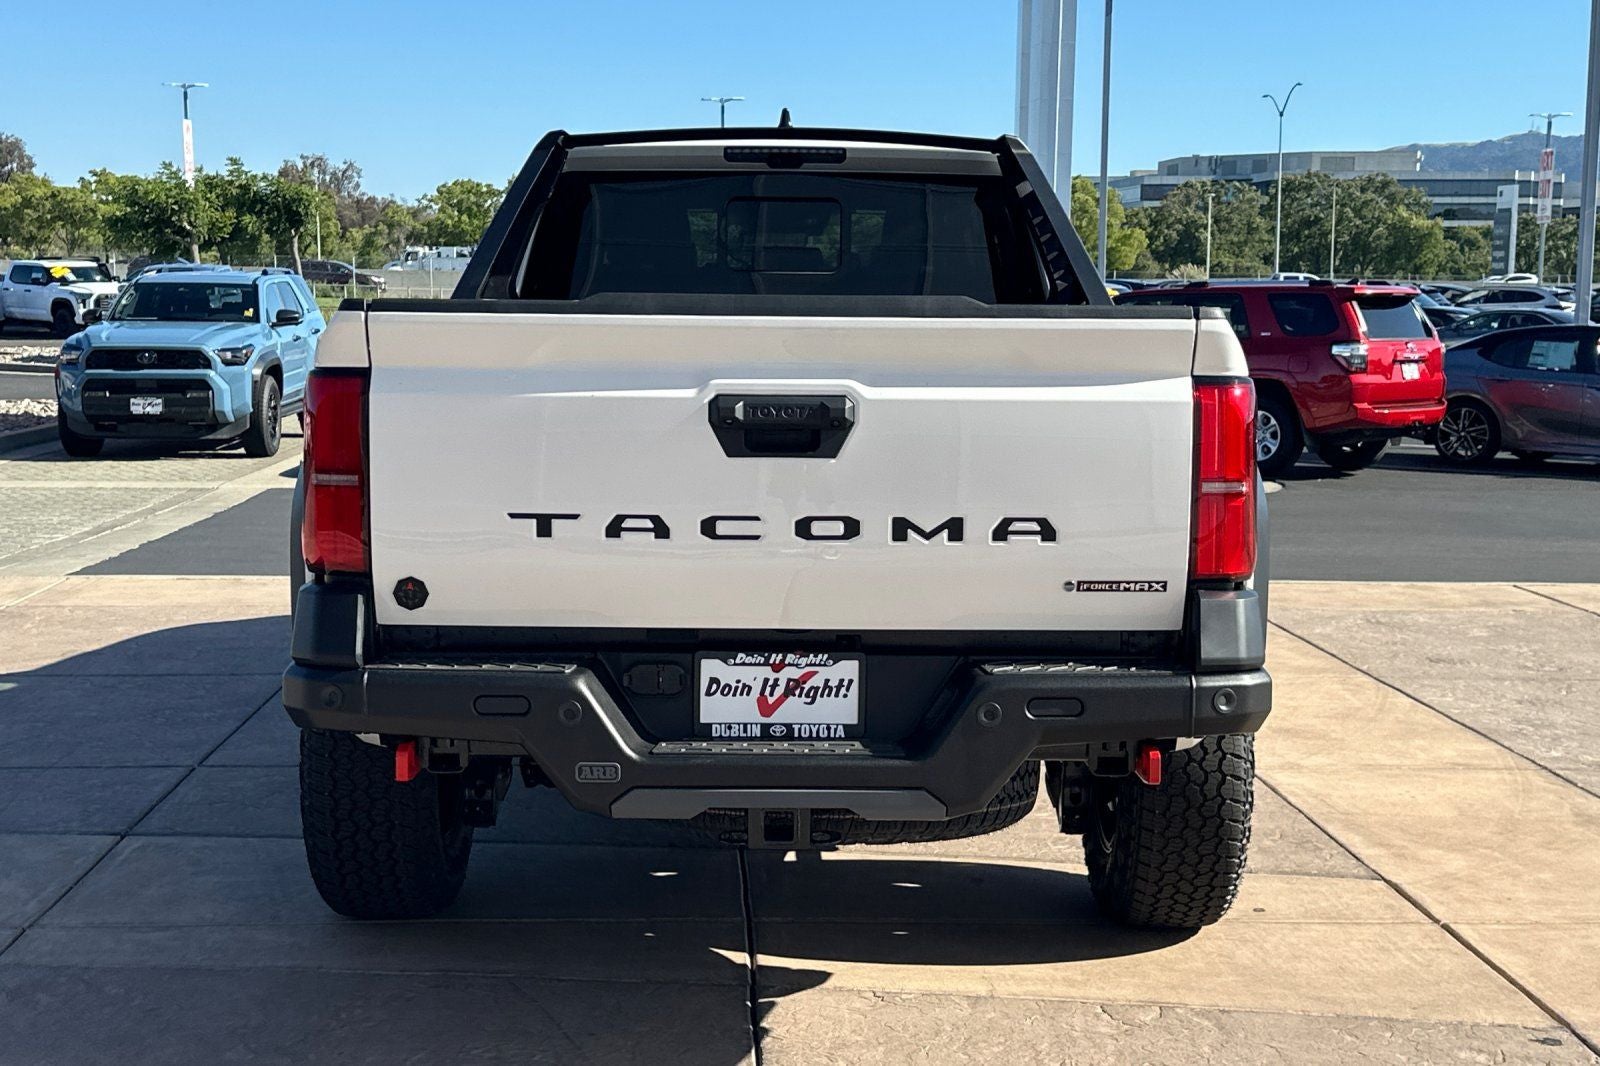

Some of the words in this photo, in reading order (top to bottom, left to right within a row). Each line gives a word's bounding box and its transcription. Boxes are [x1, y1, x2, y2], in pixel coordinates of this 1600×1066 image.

[747, 405, 815, 419] TOYOTA
[507, 513, 1057, 542] TACOMA
[735, 653, 767, 664] Doin'
[769, 654, 784, 663] It
[784, 654, 828, 667] Right!
[705, 676, 757, 697] Doin'
[760, 677, 780, 697] It
[783, 678, 854, 705] Right!
[711, 724, 761, 737] DUBLIN
[792, 725, 845, 738] TOYOTA
[580, 766, 617, 779] ARB
